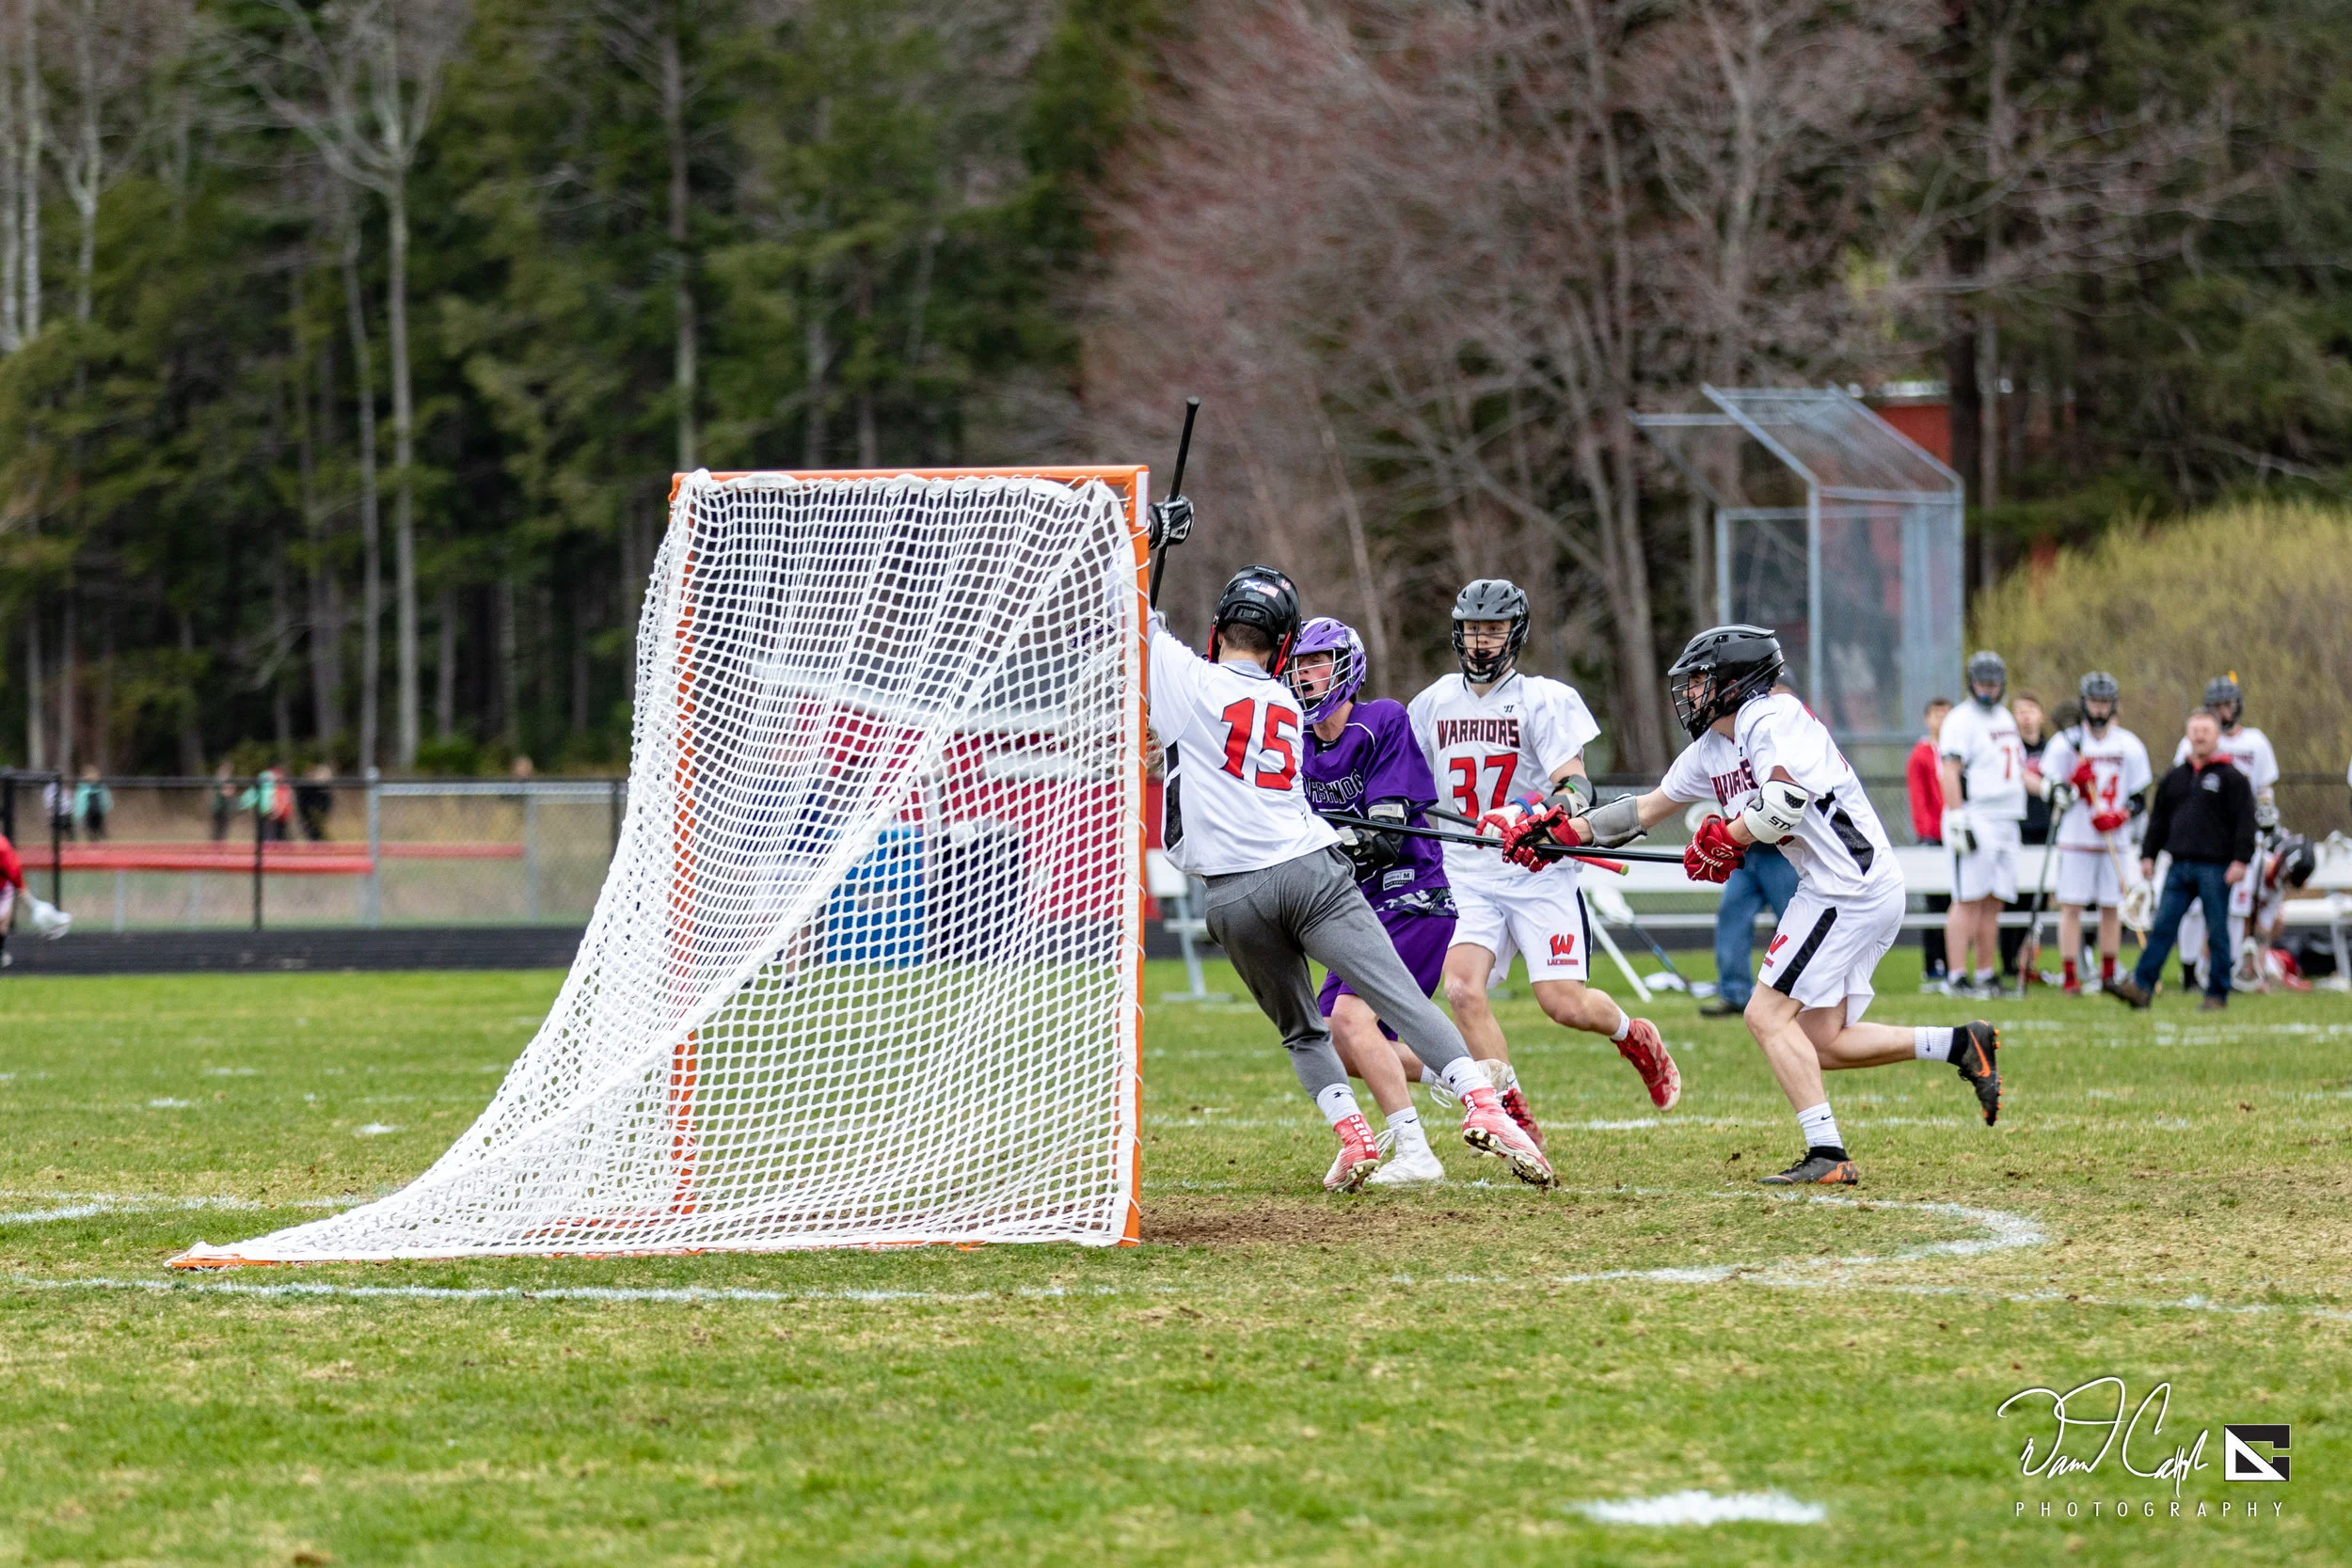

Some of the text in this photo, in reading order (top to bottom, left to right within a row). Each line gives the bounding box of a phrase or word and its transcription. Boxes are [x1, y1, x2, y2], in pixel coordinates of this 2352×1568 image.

[1219, 697, 1298, 791] 15
[1437, 719, 1521, 751] WARRIORS
[1449, 752, 1518, 820] 37
[1769, 816, 1795, 831] STX
[1549, 933, 1575, 958] W
